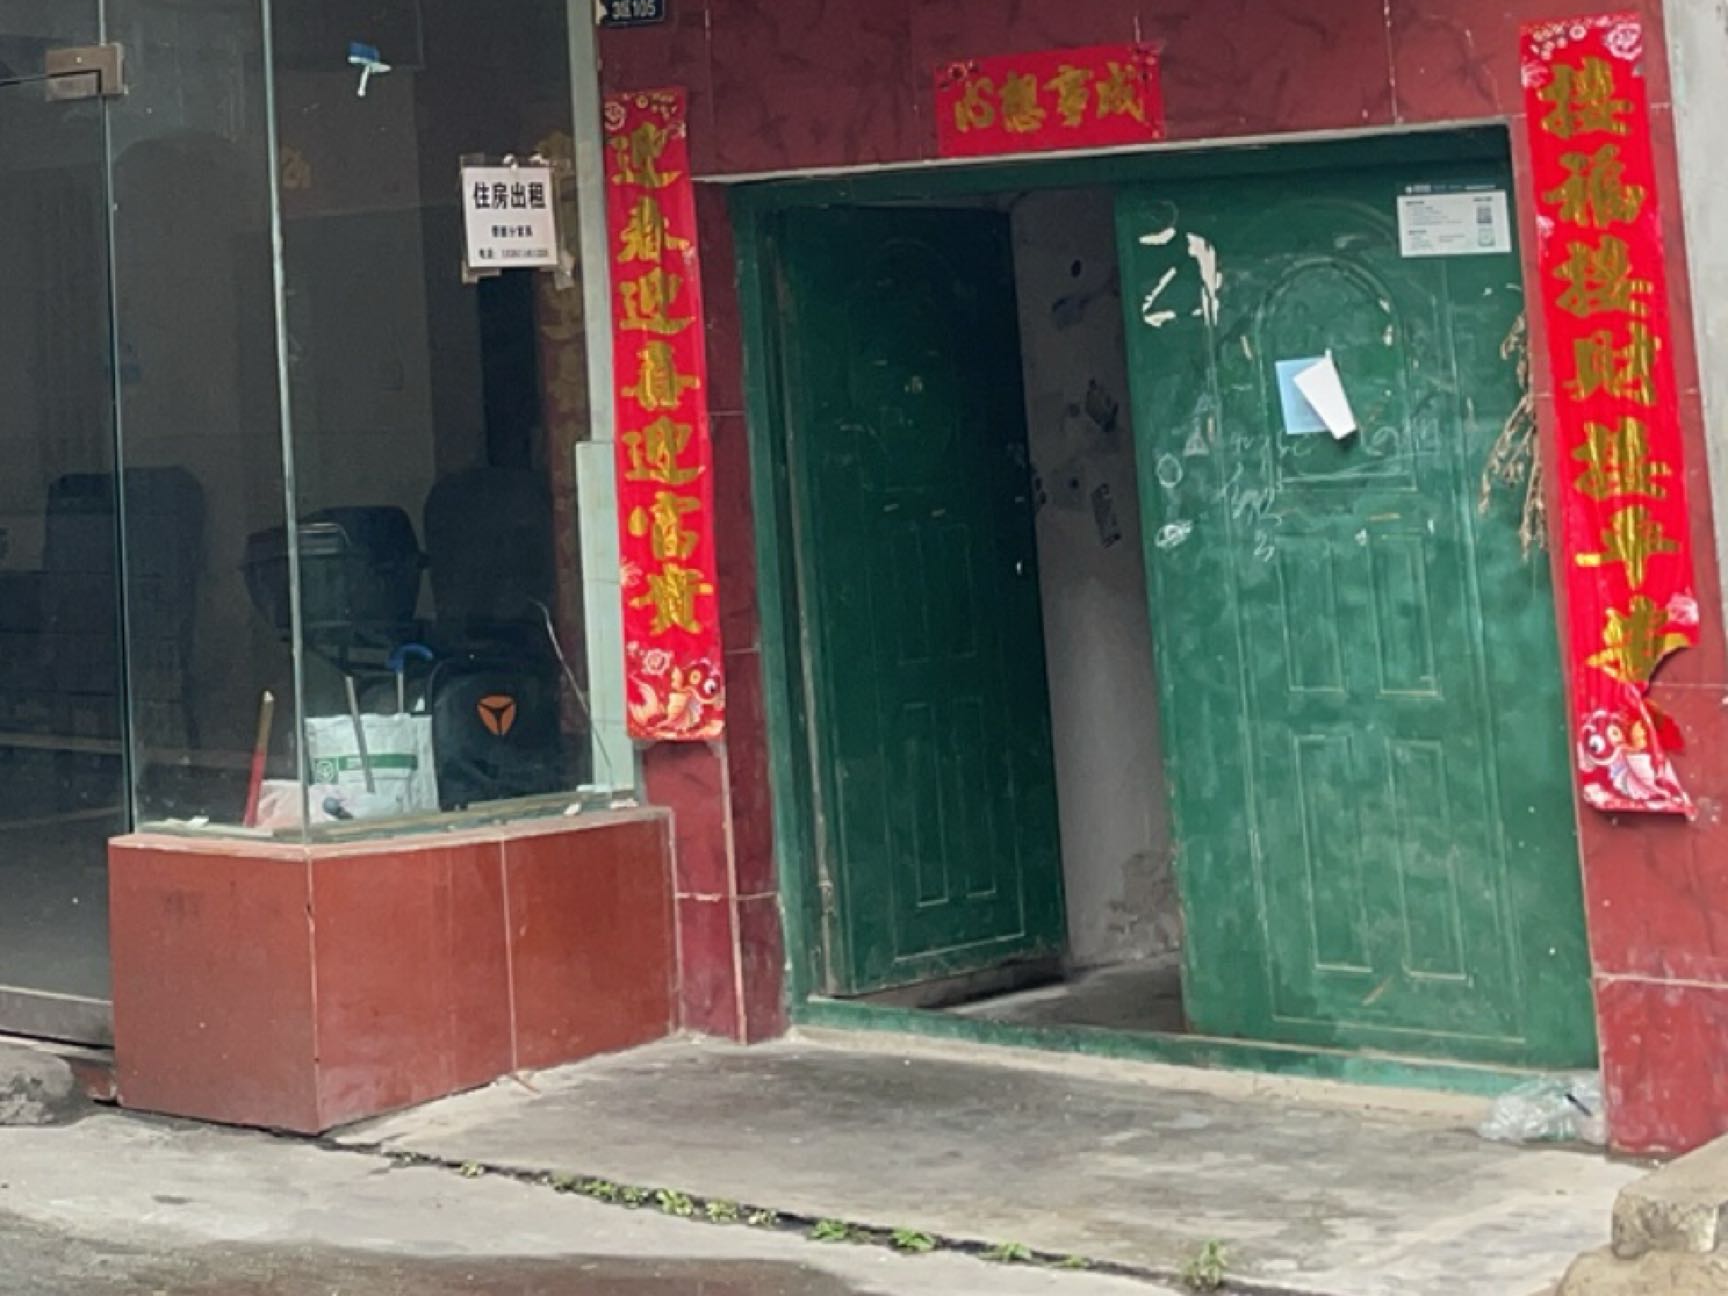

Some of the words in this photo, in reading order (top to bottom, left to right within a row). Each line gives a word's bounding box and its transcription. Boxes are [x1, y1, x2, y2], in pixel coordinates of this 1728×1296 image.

[954, 61, 1144, 133] 心想事成
[474, 181, 546, 209] 住房出租
